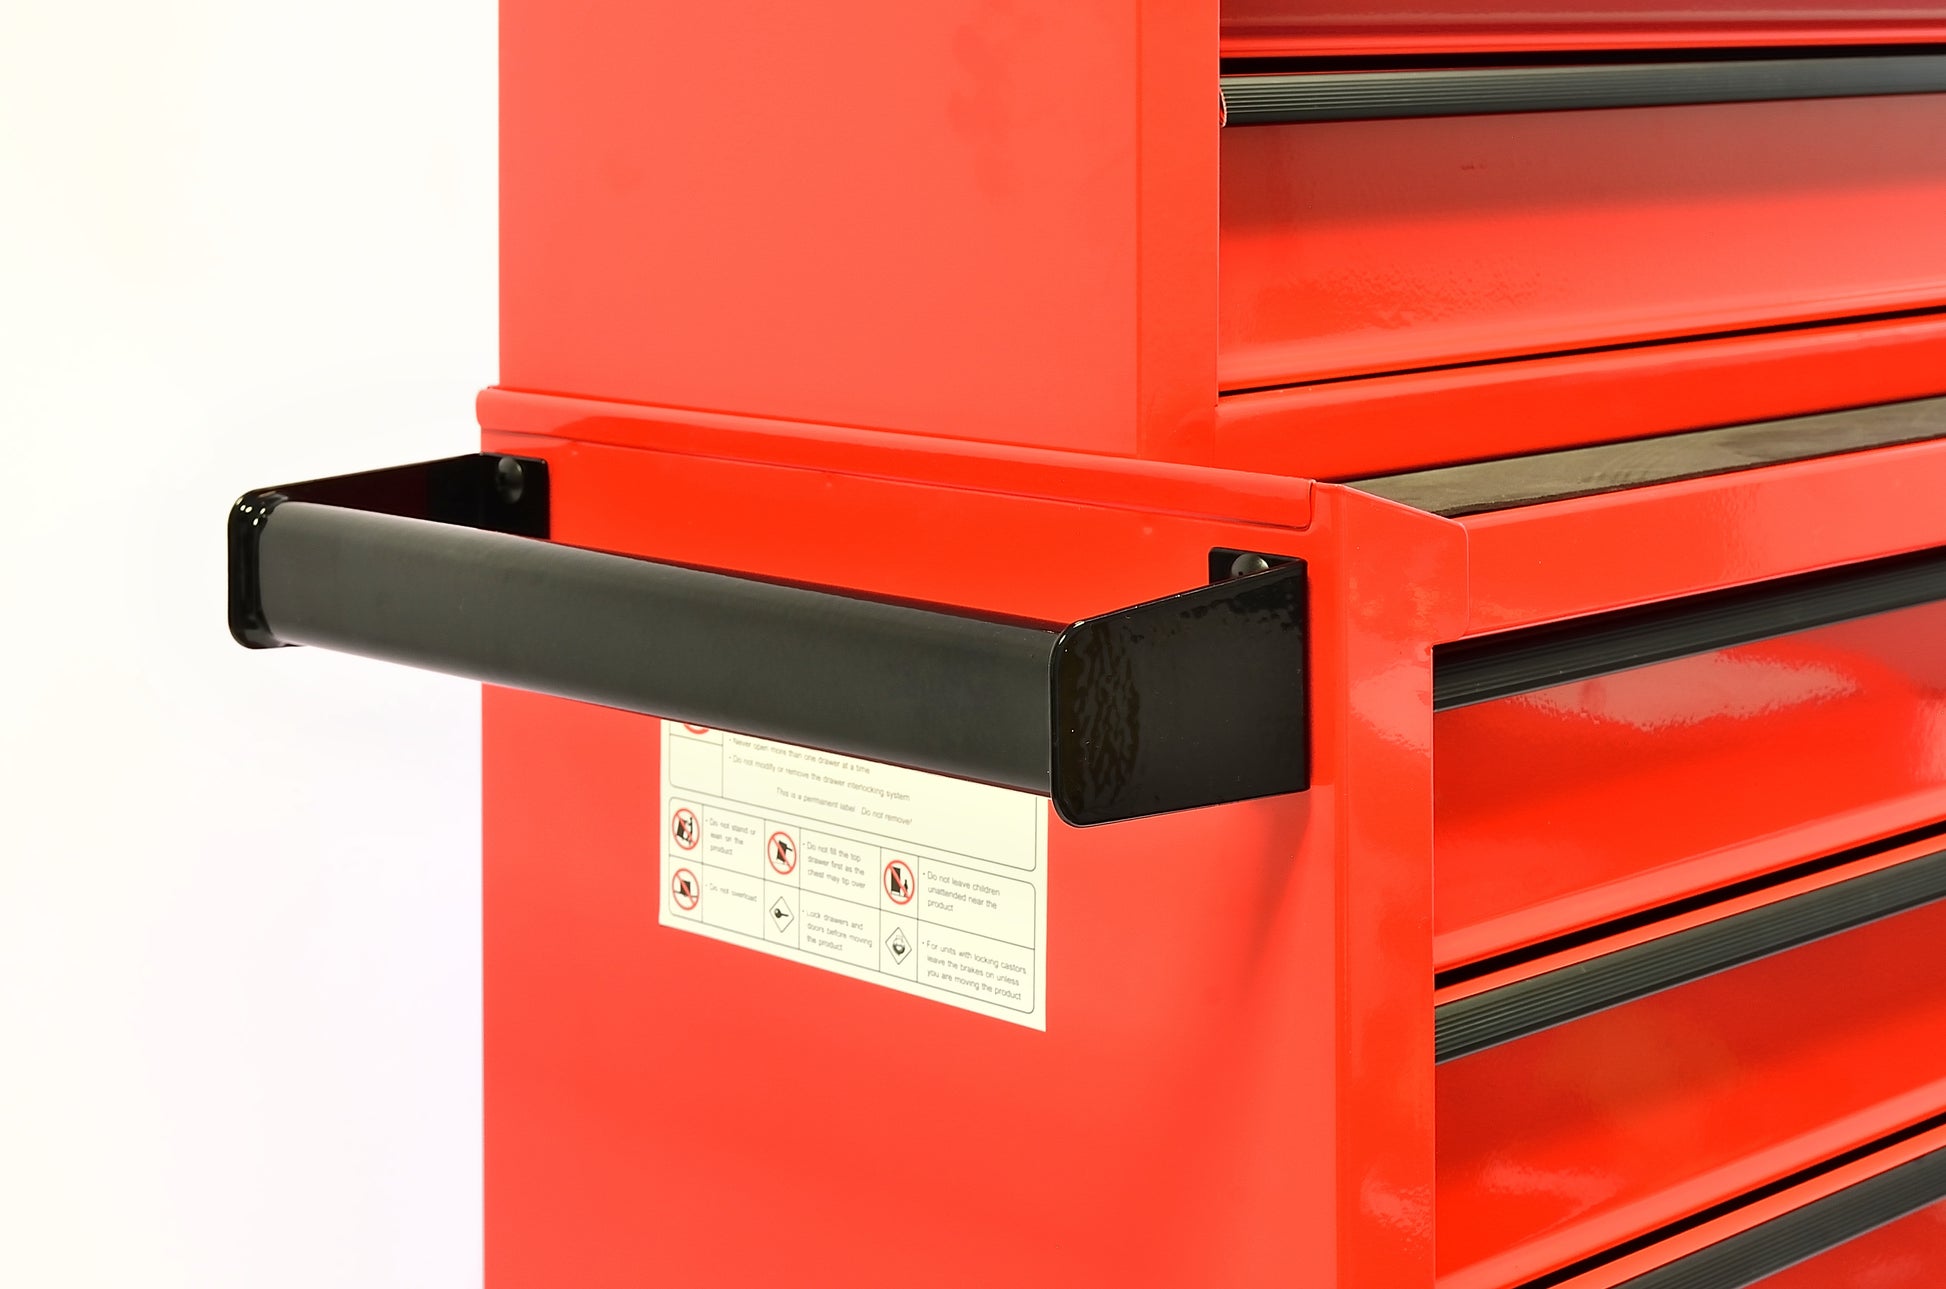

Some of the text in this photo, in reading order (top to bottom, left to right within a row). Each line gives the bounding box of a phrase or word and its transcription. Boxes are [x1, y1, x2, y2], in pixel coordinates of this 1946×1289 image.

[927, 871, 1001, 896] Do not leave children
[927, 899, 954, 912] product
[928, 887, 998, 910] unattended near the
[926, 940, 1027, 975] For units with locking castors
[926, 955, 946, 967] leave
[947, 960, 959, 970] the
[996, 973, 1020, 987] unless
[927, 970, 1022, 1001] you are moving the product
